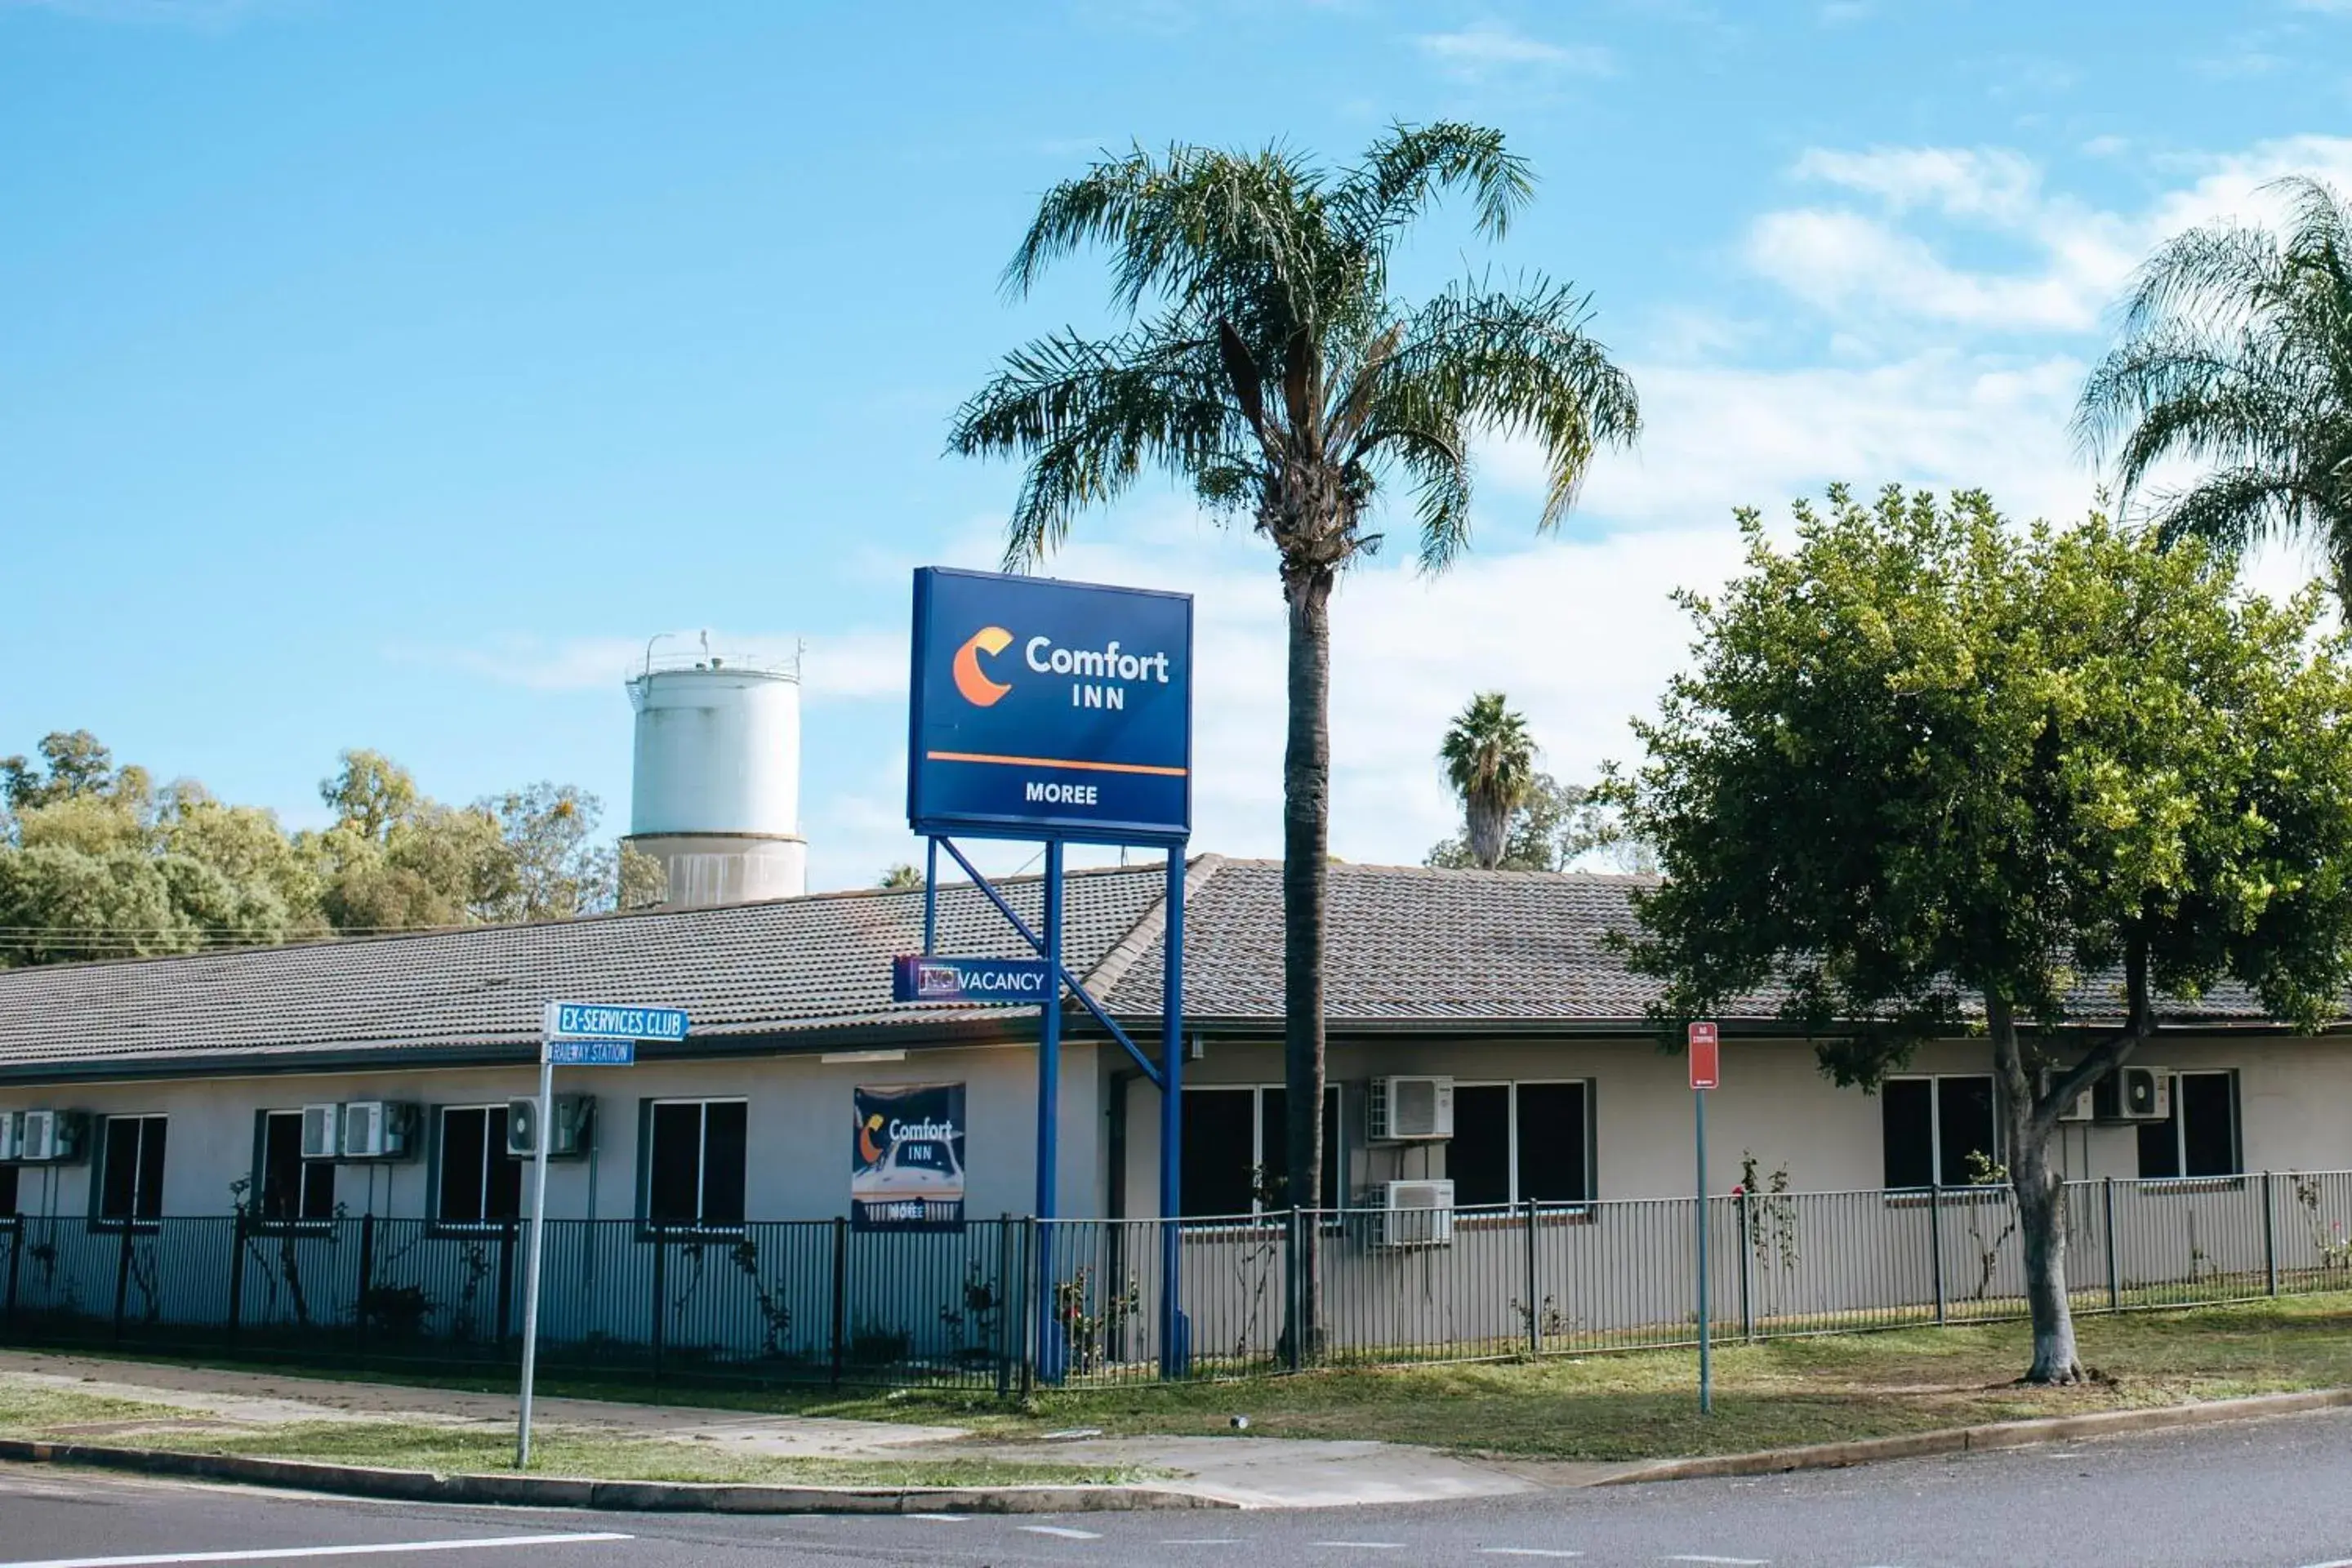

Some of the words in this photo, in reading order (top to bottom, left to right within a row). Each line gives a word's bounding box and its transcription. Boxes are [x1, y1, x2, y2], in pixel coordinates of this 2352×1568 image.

[1025, 636, 1169, 683] Comfort
[1072, 684, 1124, 710] INN
[1026, 782, 1097, 804] MOREE
[959, 971, 1045, 991] VACANCY
[562, 1007, 644, 1034] EX-SERVICES
[647, 1013, 680, 1036] CLUB
[590, 1043, 628, 1062] STATION
[889, 1116, 952, 1140] Comfort
[908, 1145, 932, 1160] INN
